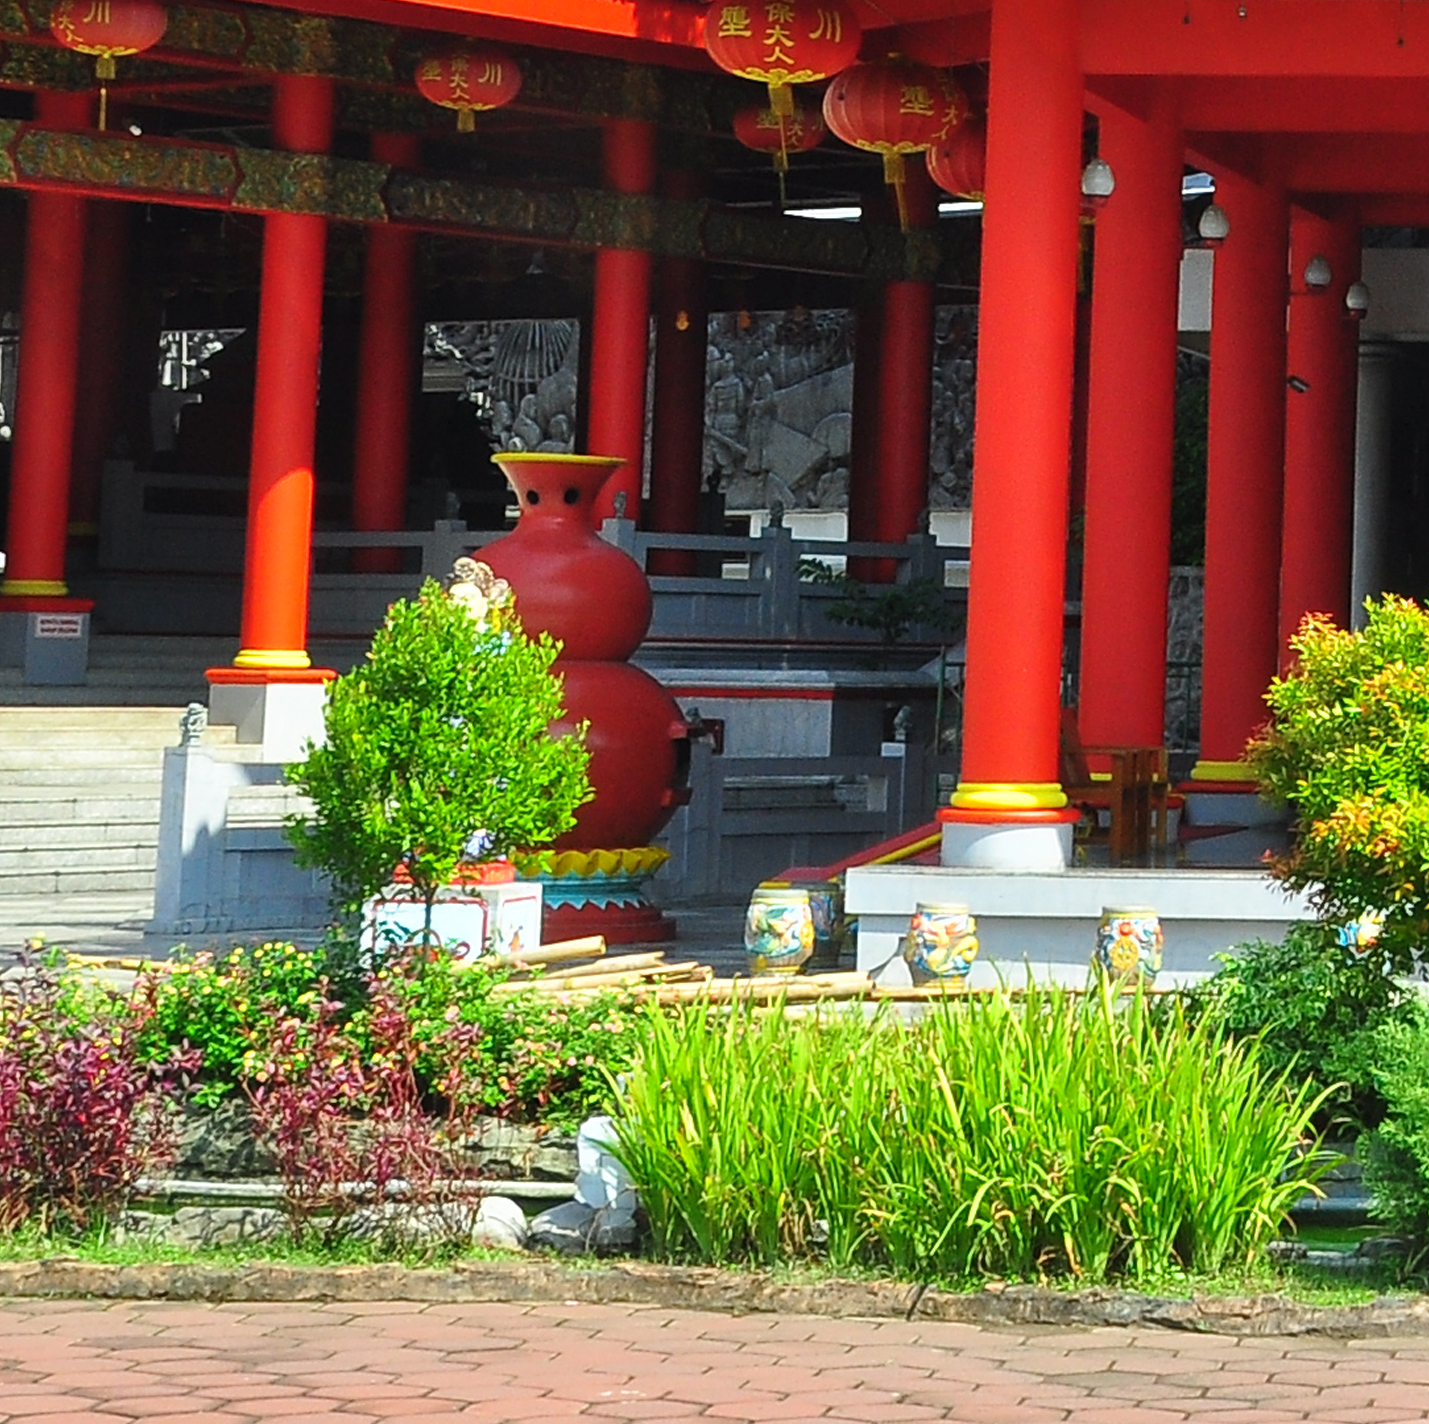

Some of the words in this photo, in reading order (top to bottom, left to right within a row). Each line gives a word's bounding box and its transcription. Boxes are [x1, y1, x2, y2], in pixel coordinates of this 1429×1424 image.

[83, 0, 111, 24] 川
[809, 8, 842, 43] 川
[478, 63, 502, 86] 川
